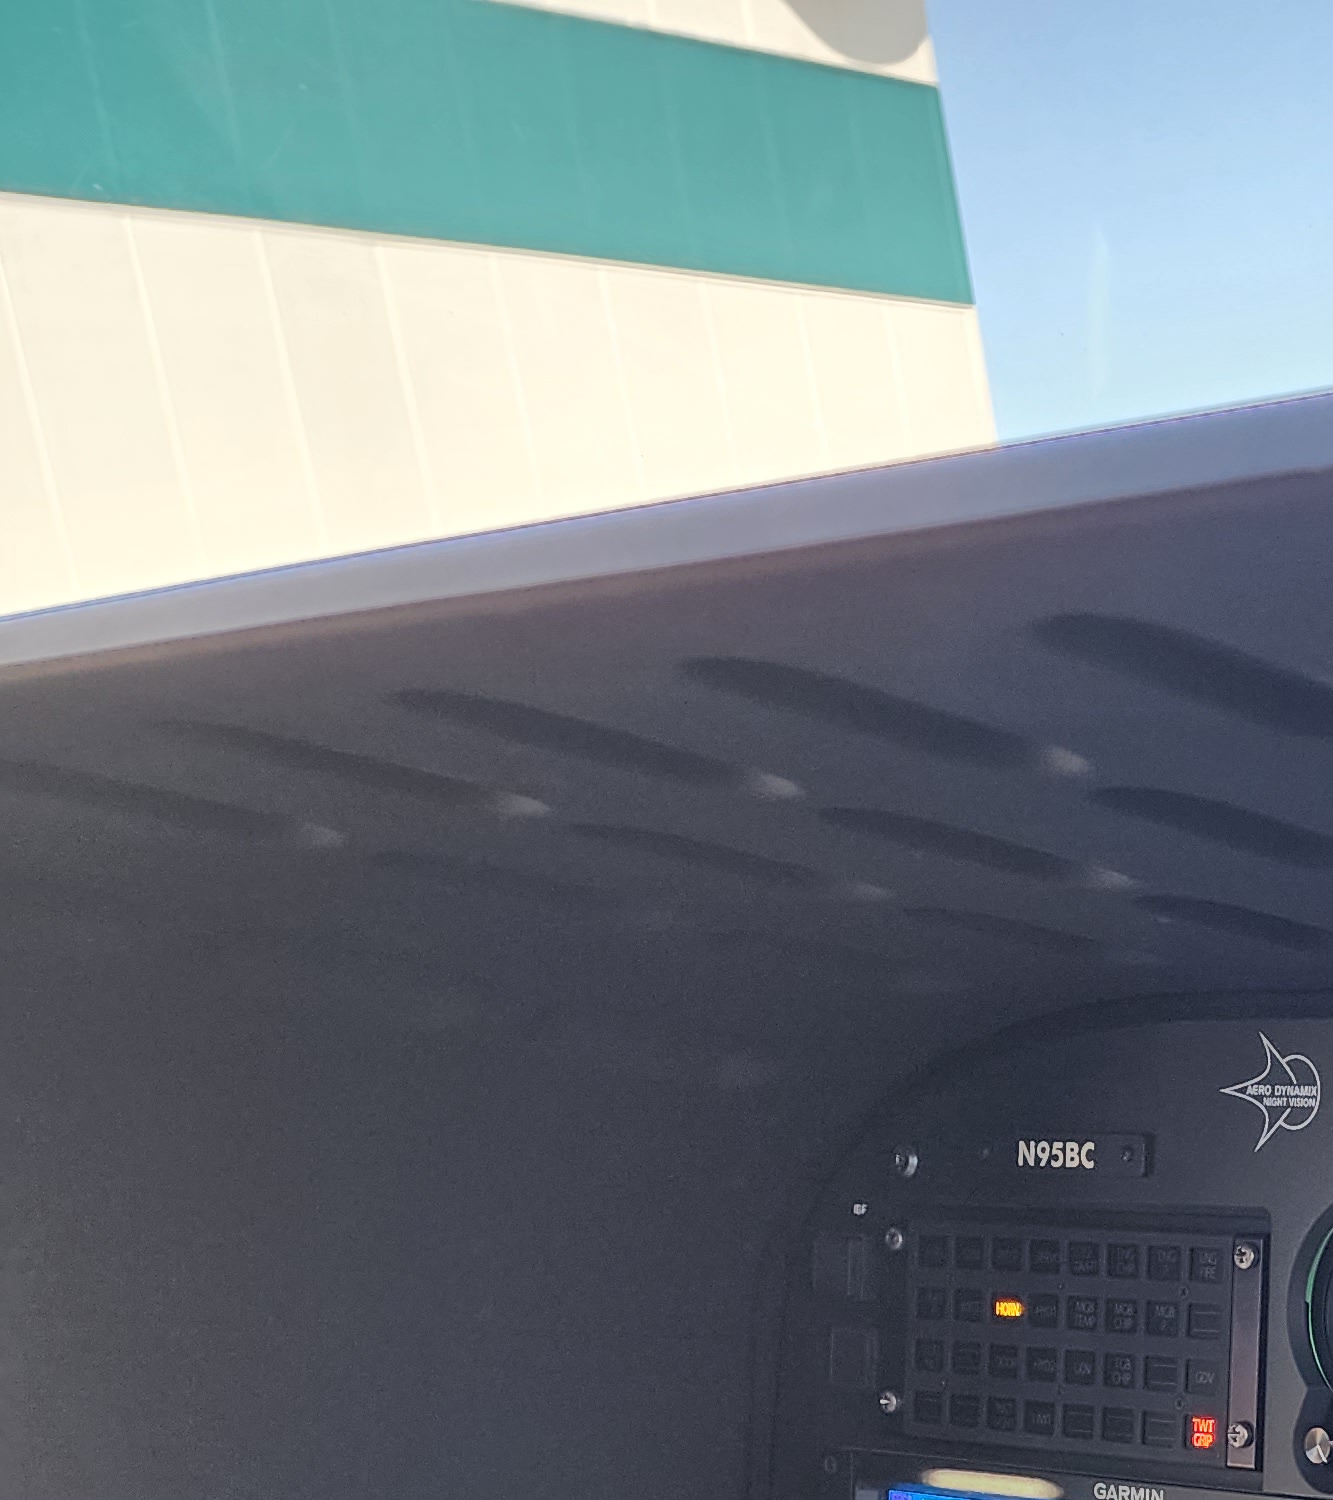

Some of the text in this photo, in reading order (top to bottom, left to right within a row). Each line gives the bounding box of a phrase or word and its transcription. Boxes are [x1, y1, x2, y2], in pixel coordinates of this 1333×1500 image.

[1246, 1085, 1317, 1096] AERO DYNAMIX
[1263, 1097, 1316, 1107] NIGHT VISION
[1018, 1141, 1095, 1169] N95BC
[1192, 1417, 1216, 1433] TWT
